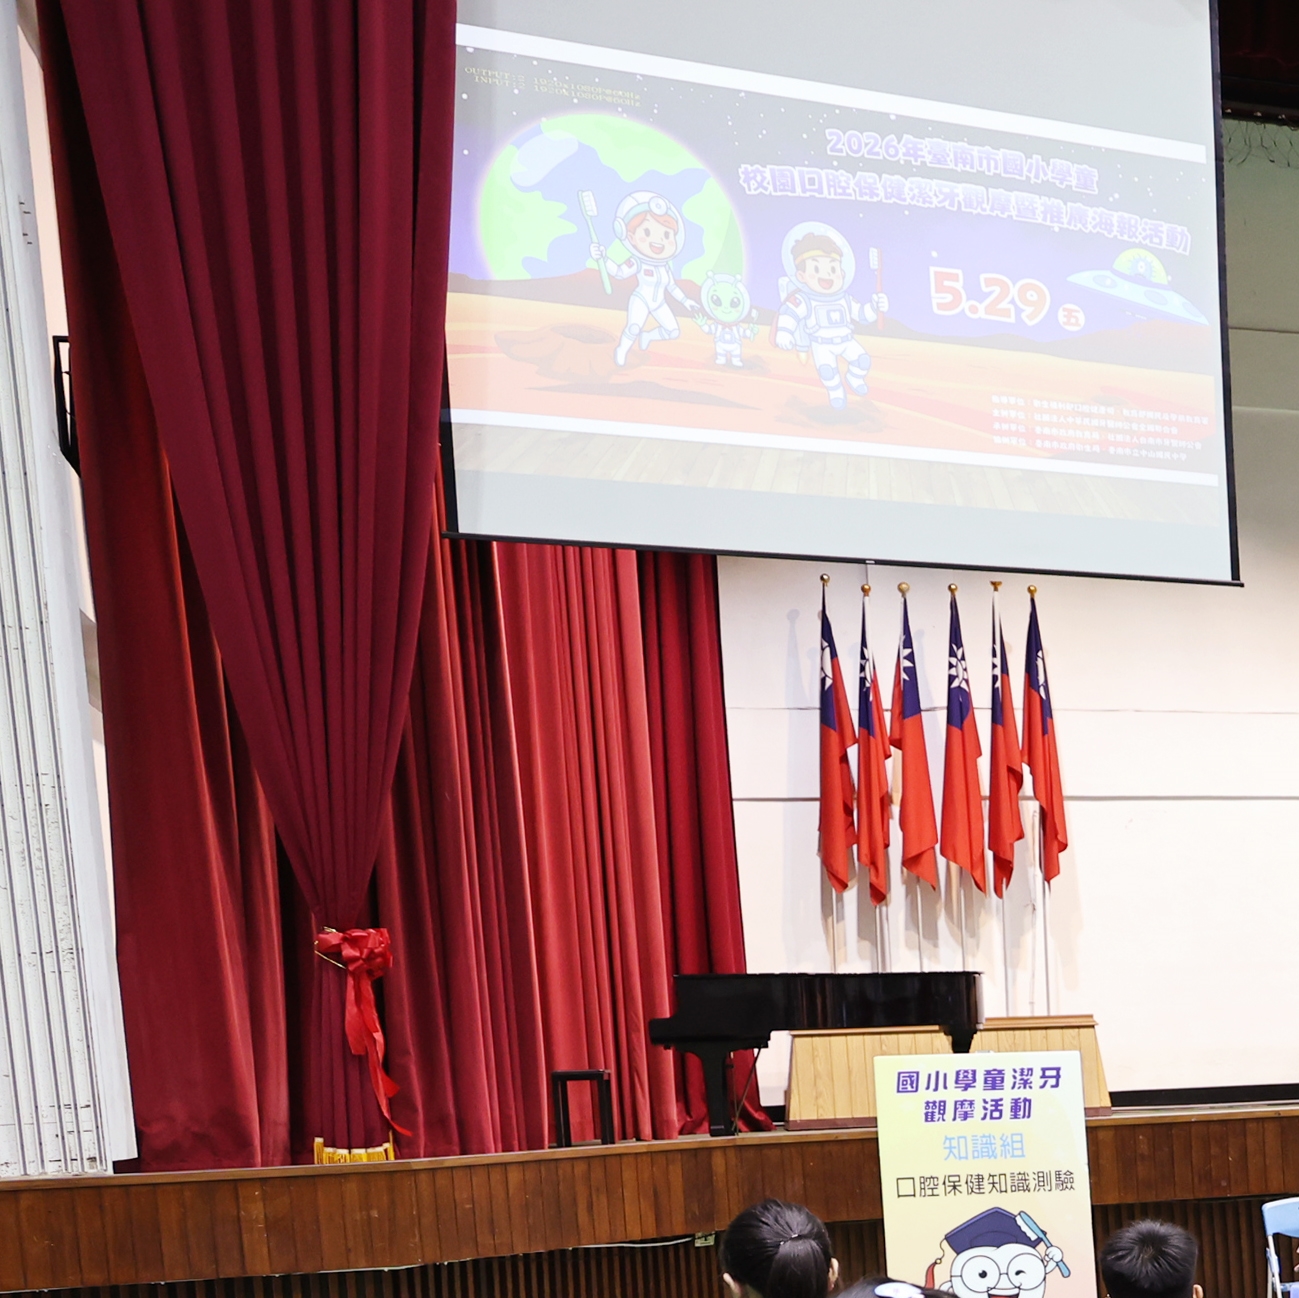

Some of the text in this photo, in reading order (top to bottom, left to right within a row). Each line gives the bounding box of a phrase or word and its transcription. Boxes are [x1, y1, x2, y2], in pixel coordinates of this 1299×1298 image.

[826, 128, 1099, 194] 2026年臺南市國小學童
[739, 164, 1190, 254] 校園口腔保健潔牙觀摩暨推廣海報活動
[929, 266, 1083, 329] 5.29 五
[896, 1066, 1062, 1094] 國小學童潔牙
[923, 1098, 1032, 1123] 觀摩活動
[943, 1132, 1026, 1161] 知識組
[896, 1169, 1076, 1198] 口腔保健知識測驗
